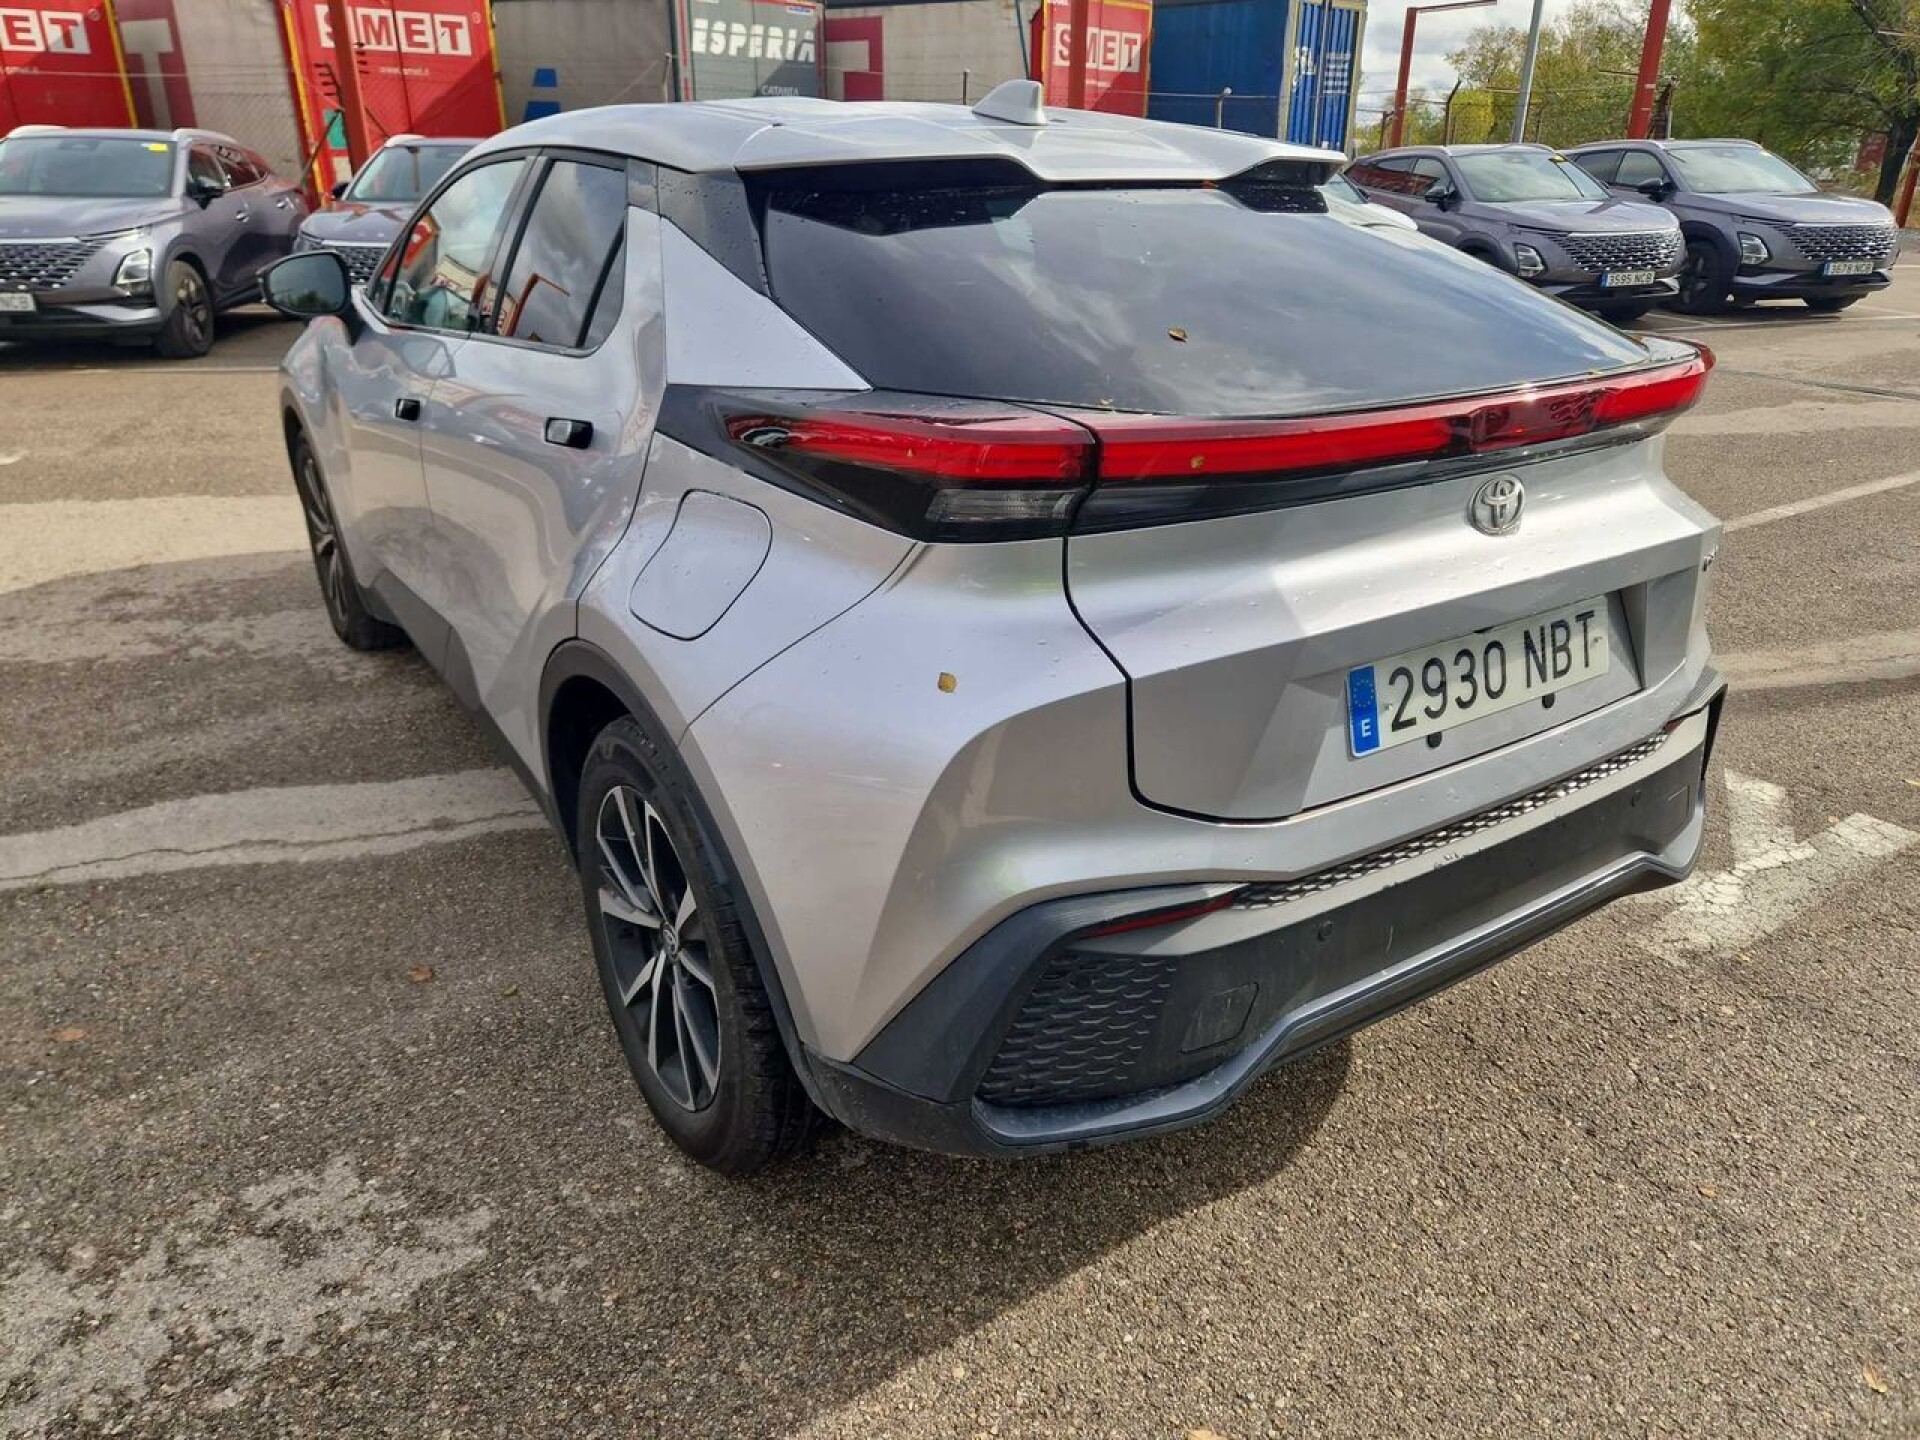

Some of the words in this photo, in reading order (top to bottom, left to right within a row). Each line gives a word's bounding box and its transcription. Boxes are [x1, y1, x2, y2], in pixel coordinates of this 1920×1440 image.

[692, 18, 815, 62] ESPERIA
[1389, 640, 1506, 732] 2930
[1523, 610, 1595, 689] NBT
[1360, 719, 1372, 737] E
